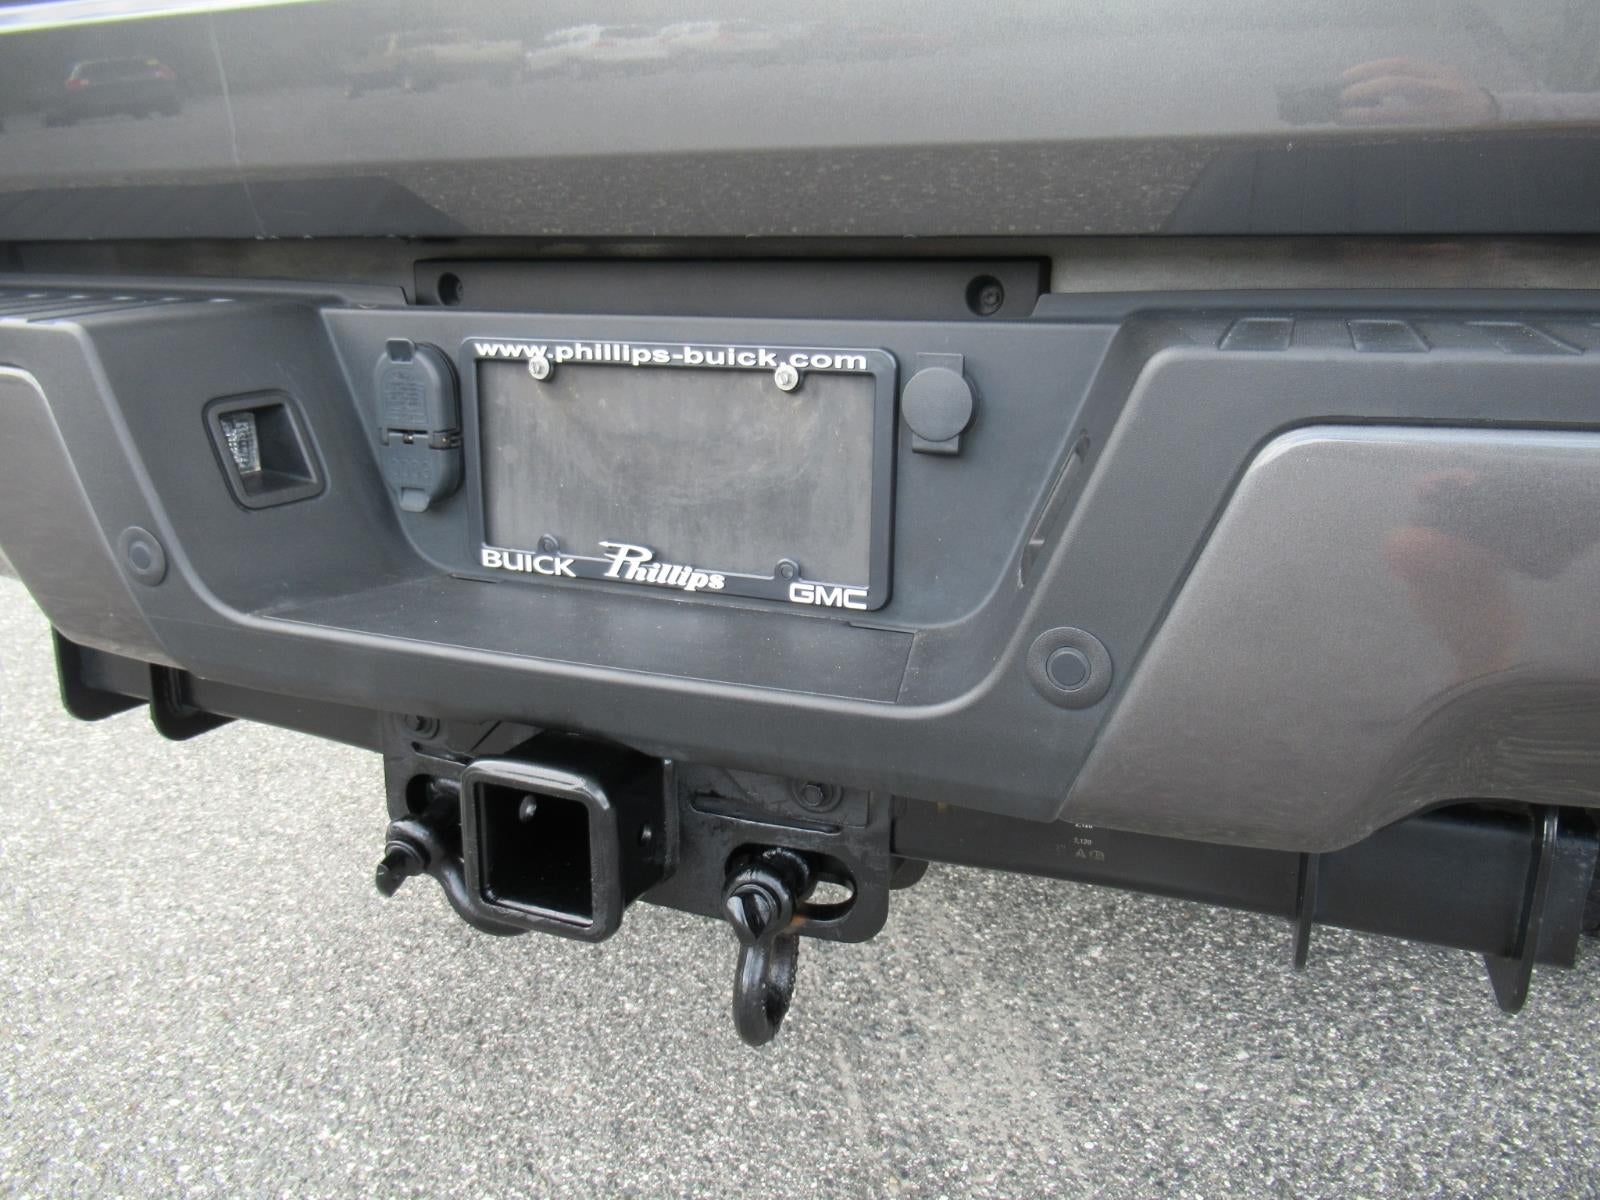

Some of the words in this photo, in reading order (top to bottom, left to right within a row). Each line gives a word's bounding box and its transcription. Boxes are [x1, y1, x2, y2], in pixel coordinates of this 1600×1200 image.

[474, 342, 868, 370] www.phillips-buick.com
[480, 550, 577, 578] BUICK
[598, 541, 726, 592] Phillips
[788, 582, 868, 611] GMC
